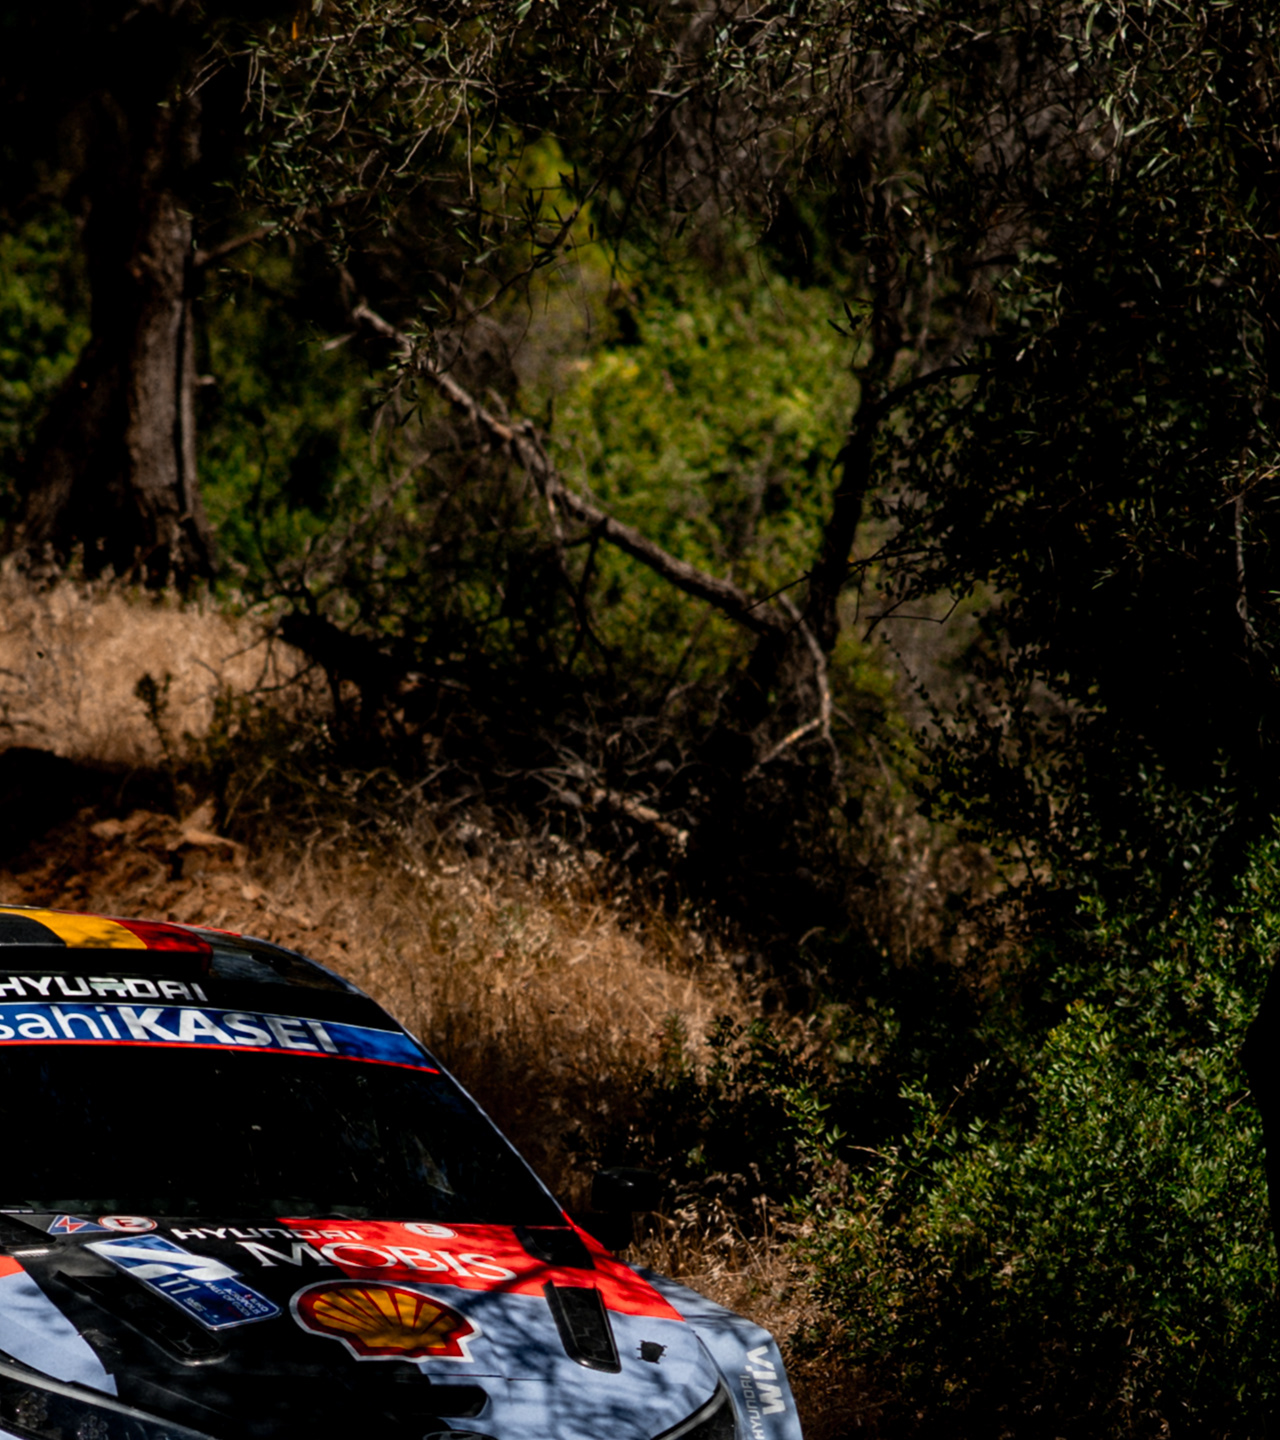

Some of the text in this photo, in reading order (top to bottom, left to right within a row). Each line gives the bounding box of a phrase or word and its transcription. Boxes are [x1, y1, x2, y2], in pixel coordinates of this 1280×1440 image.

[170, 1227, 364, 1241] HYUNDAI
[235, 1241, 518, 1282] MOBIS
[158, 1276, 201, 1296] 11
[744, 1345, 787, 1415] WIA
[739, 1375, 766, 1440] HYUNDAI
